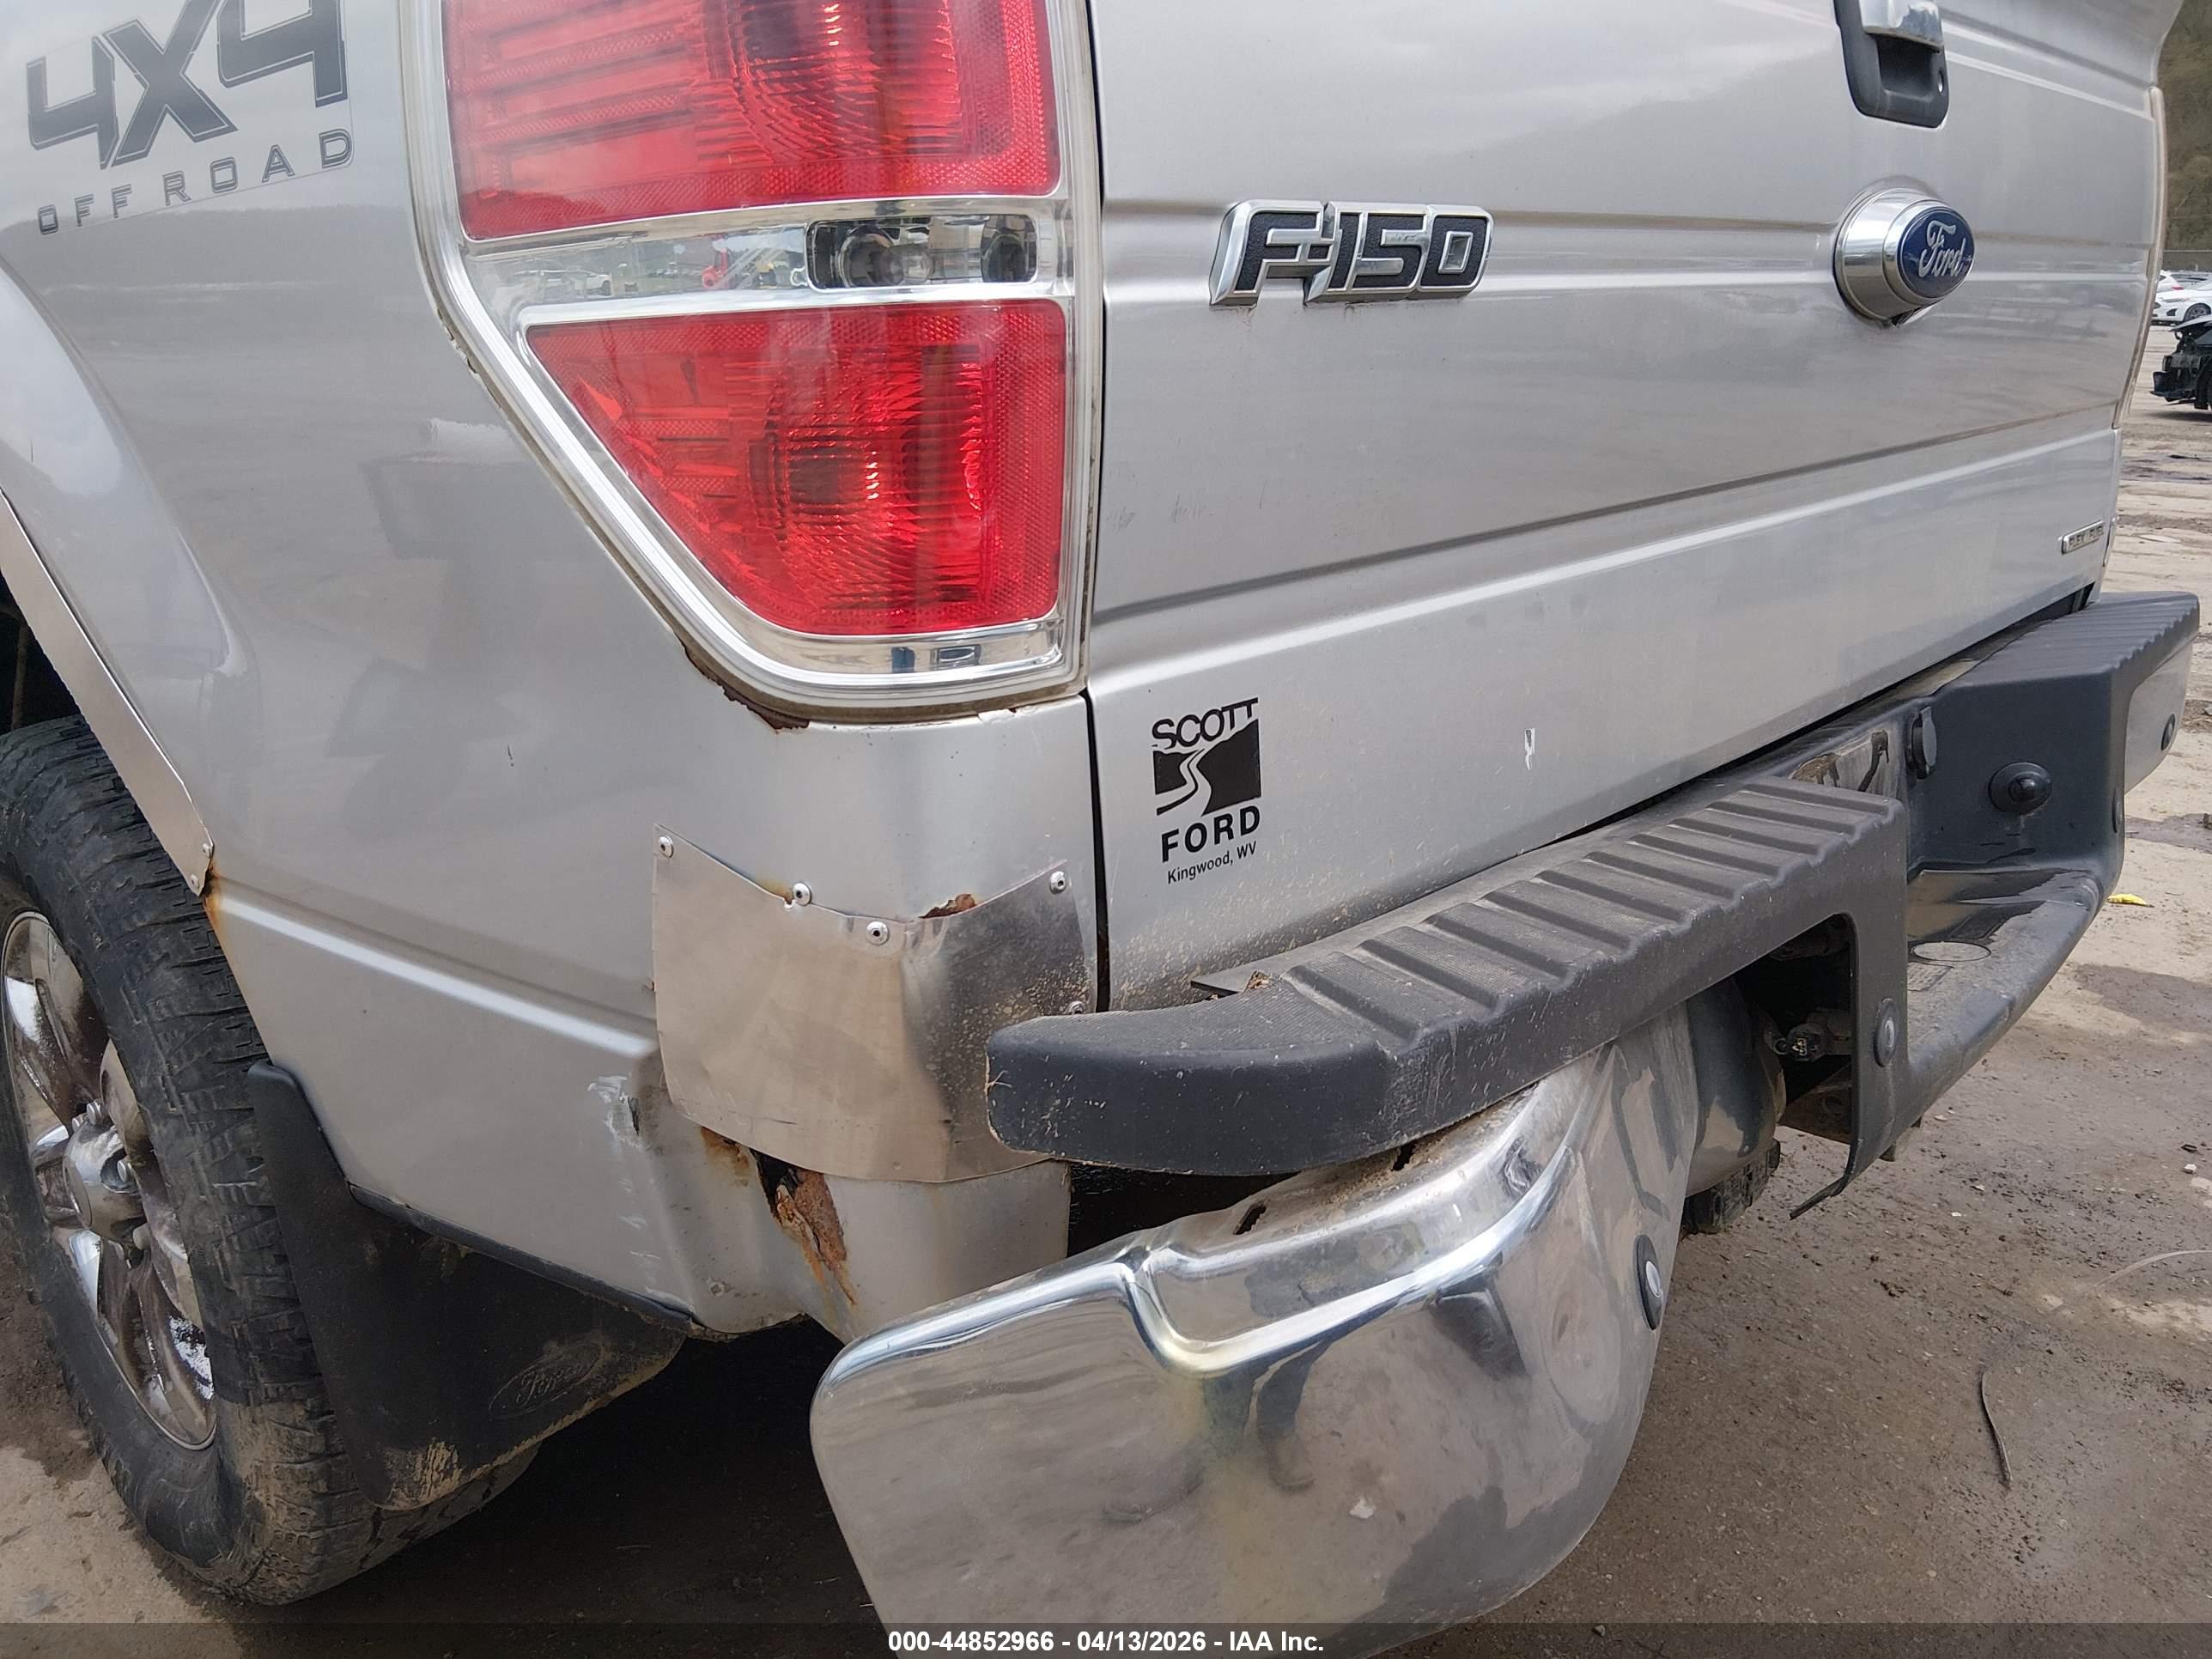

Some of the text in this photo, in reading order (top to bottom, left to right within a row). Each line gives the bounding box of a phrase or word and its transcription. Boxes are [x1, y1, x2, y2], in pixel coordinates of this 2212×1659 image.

[26, 0, 349, 169] 4X4
[1210, 199, 1494, 306] F-150
[1917, 220, 1966, 278] Ford
[1152, 697, 1259, 750] SCOTT
[1161, 805, 1260, 863] FORD
[1168, 841, 1256, 884] Kingwood, WV
